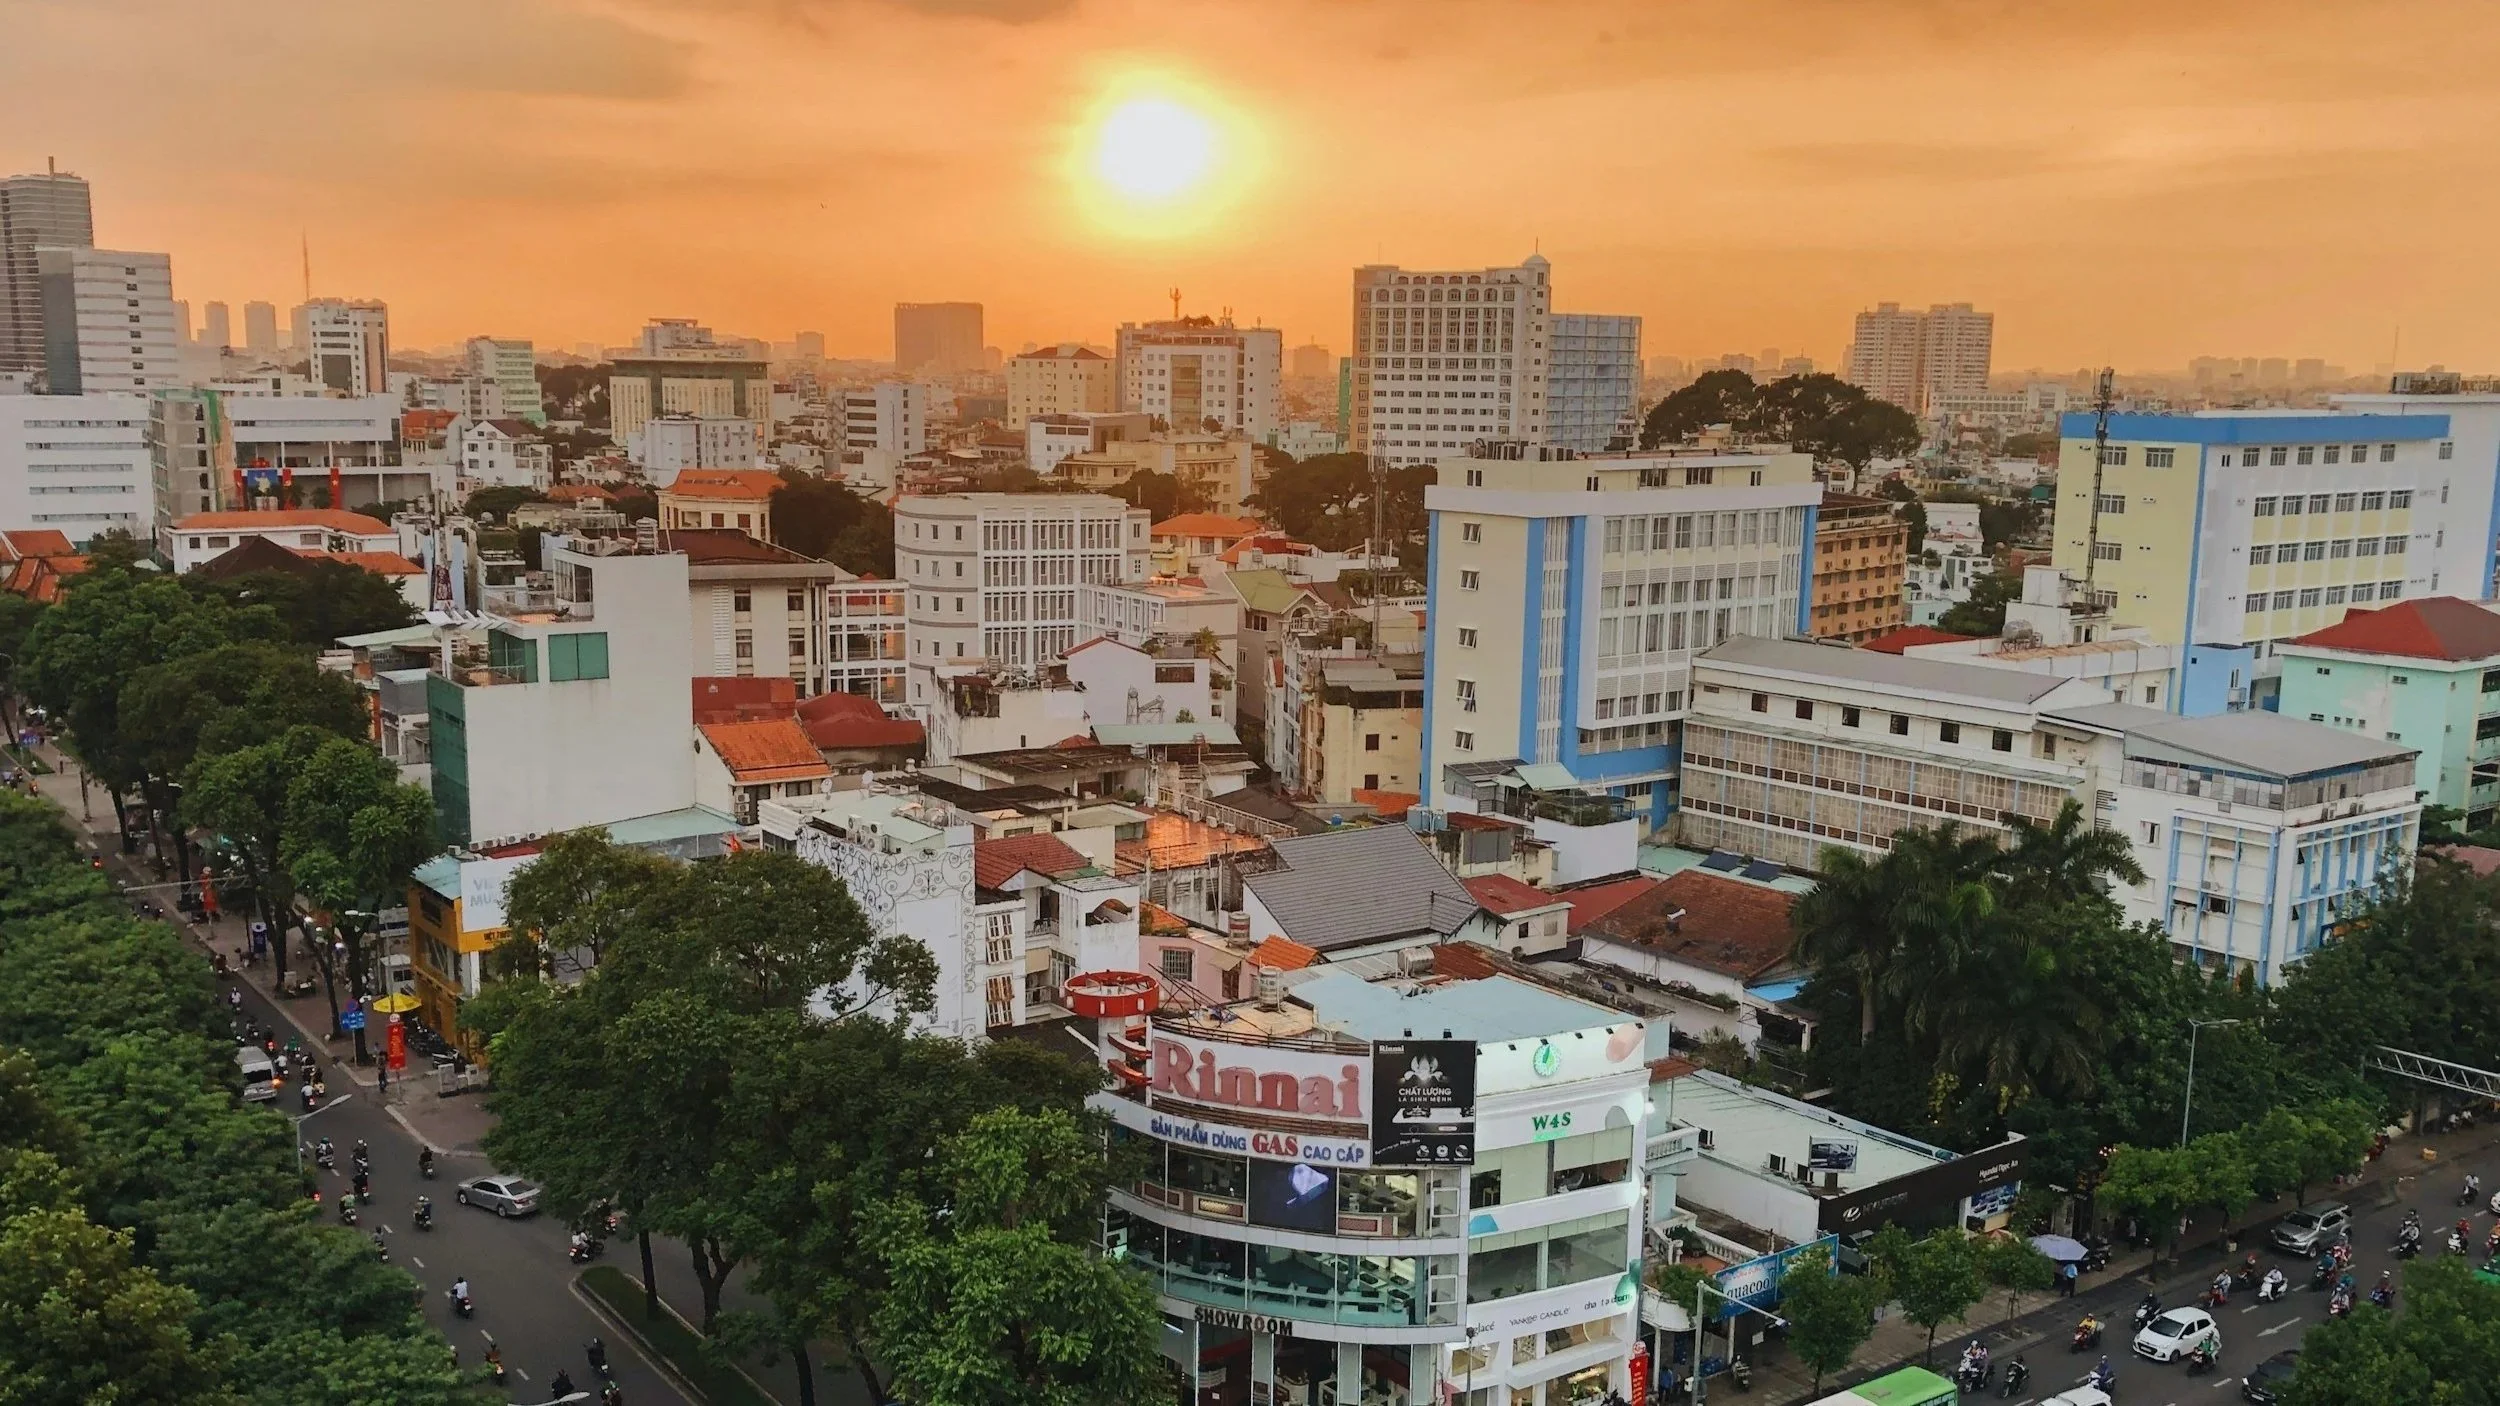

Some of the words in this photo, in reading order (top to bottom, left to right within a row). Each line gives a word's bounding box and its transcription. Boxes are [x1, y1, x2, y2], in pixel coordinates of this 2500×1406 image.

[1151, 1036, 1363, 1118] Rinnai
[1398, 1086, 1421, 1096] CHẤT
[1422, 1086, 1452, 1097] LƯỢNG
[1531, 1111, 1571, 1131] W4S
[1151, 1115, 1172, 1137] SẢN
[1175, 1122, 1208, 1145] PHẨM
[1212, 1130, 1247, 1151] DÙNG
[1252, 1133, 1298, 1157] GAS
[1303, 1144, 1331, 1161] CAO
[1336, 1142, 1365, 1164] CẤP
[1194, 1305, 1293, 1336] SHOWROOM
